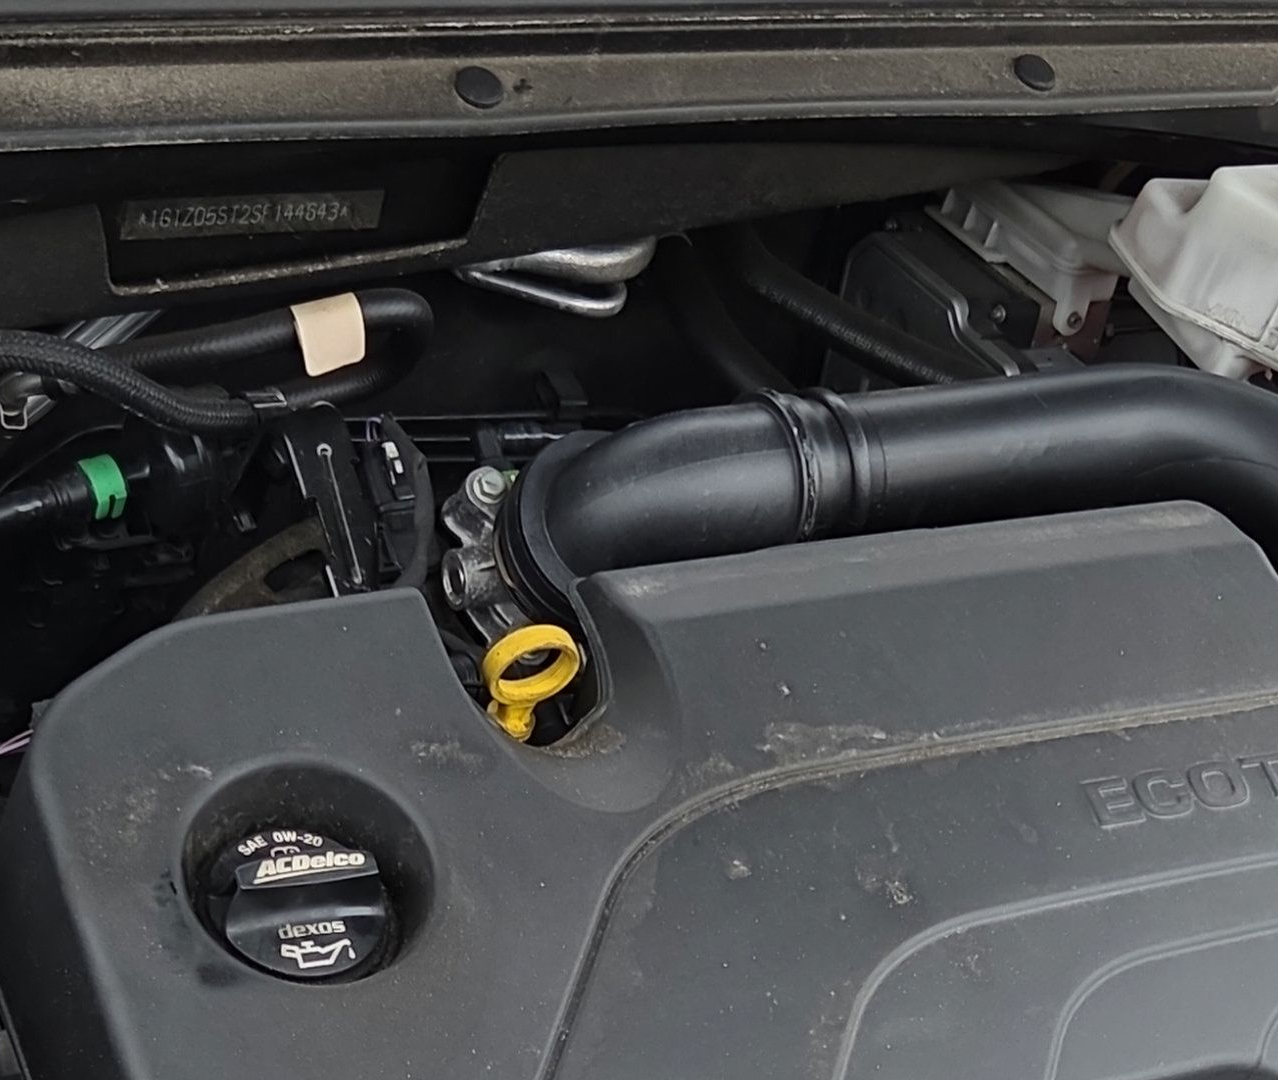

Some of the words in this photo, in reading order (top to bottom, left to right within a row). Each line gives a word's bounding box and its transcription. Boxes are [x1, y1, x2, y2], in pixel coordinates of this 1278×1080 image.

[238, 835, 268, 857] SAE
[272, 831, 323, 847] 0W-20
[255, 851, 366, 878] ACDelco
[278, 920, 346, 940] dexos
